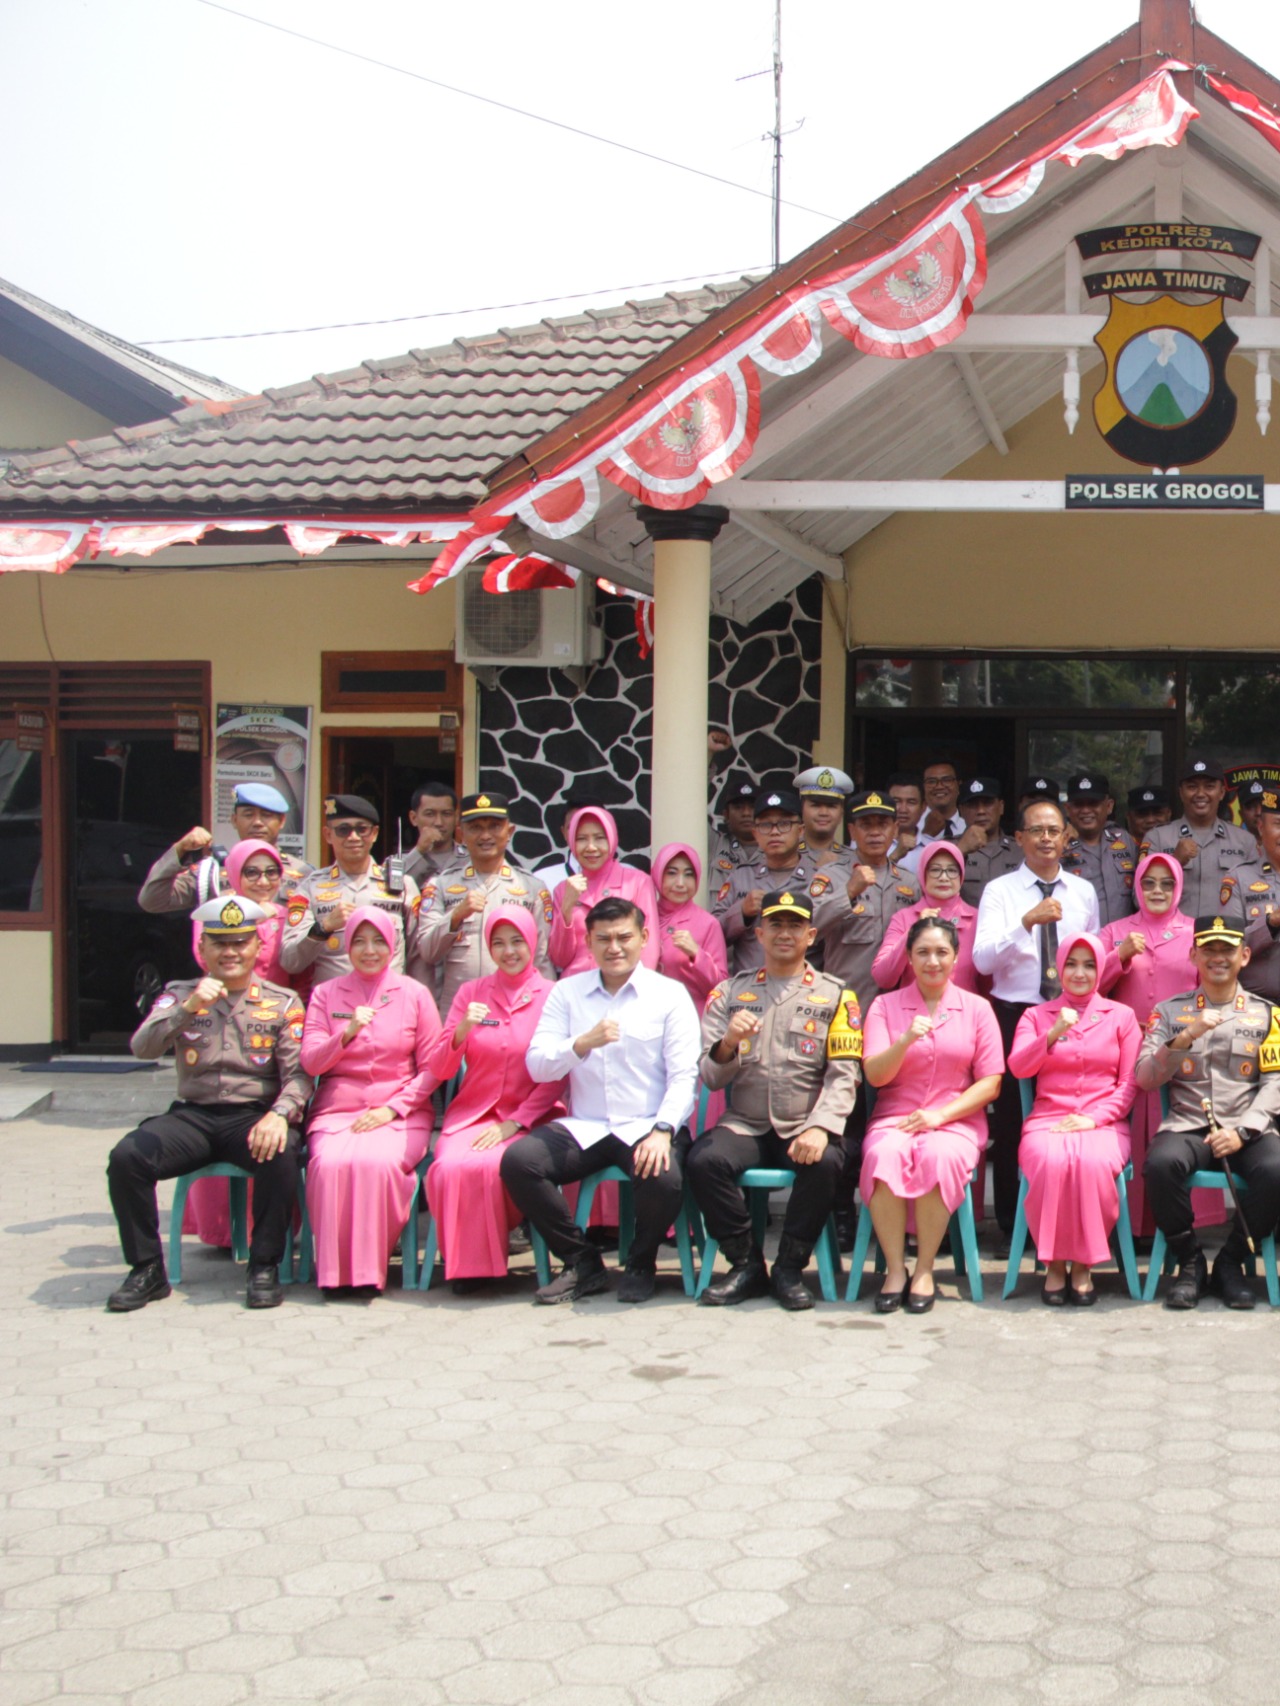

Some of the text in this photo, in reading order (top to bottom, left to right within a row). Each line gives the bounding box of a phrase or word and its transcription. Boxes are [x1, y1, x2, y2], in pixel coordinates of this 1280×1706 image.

[1125, 225, 1213, 237] POLRES
[1101, 236, 1234, 251] KEDIRI KOTA
[1101, 272, 1227, 291] JAWA TIMUR
[1069, 483, 1259, 500] POLSEK GROGOL
[1231, 769, 1260, 784] JAWA
[316, 904, 336, 915] AGU
[796, 1005, 832, 1020] POLRI
[1235, 1028, 1266, 1039] POLRI
[1262, 1047, 1278, 1065] KA
